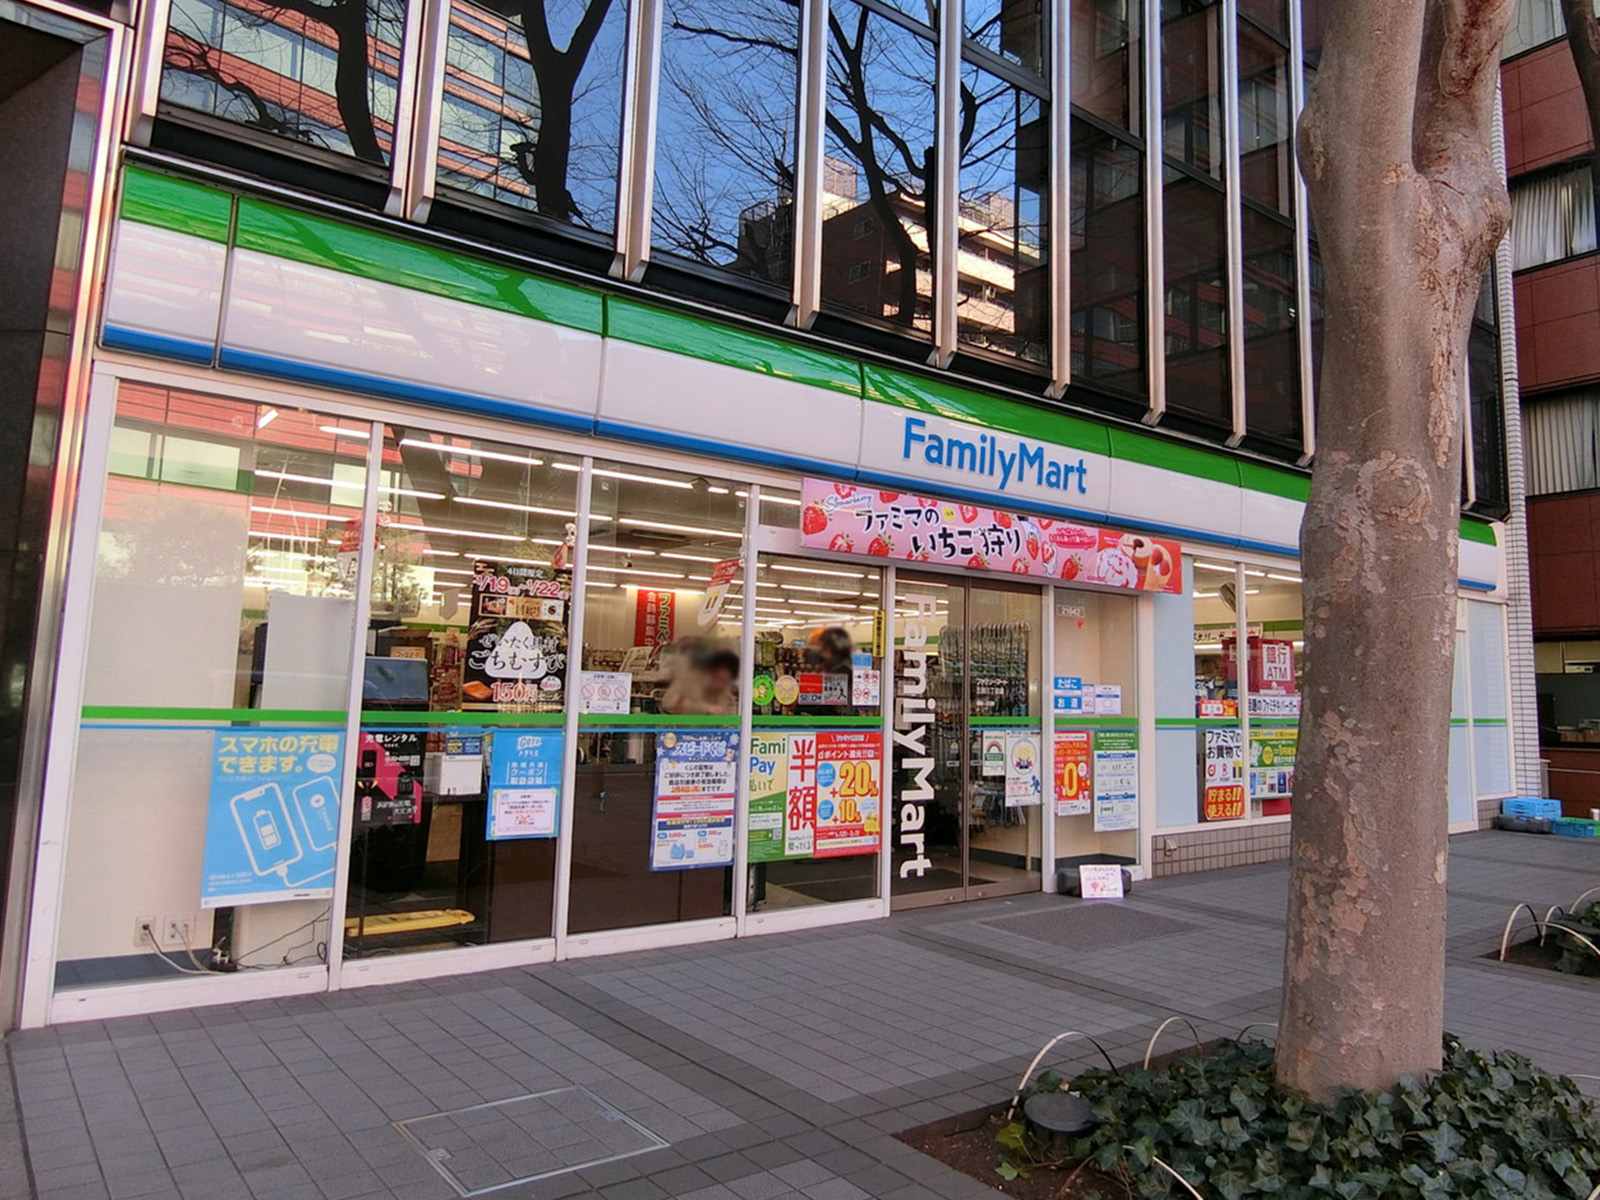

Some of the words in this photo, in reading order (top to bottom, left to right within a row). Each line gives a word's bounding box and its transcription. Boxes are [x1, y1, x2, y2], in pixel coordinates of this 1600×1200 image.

[903, 416, 1088, 494] FamilyMart
[855, 506, 940, 532] ファミマの
[911, 523, 1021, 559] いちご狩り
[468, 648, 567, 673] ごちむすび
[1265, 645, 1288, 665] 銀行
[1266, 666, 1288, 680] ATM
[219, 734, 340, 755] スマホの充電
[365, 733, 418, 743] 充電レンタル
[893, 592, 936, 880] FamilyMart
[672, 741, 727, 757] スピードくじ
[750, 738, 786, 755] Fami
[1207, 745, 1242, 760] お買物で
[218, 755, 303, 774] できます。
[510, 768, 544, 776] クーポン
[749, 756, 776, 775] Pay
[788, 739, 816, 831] 半額
